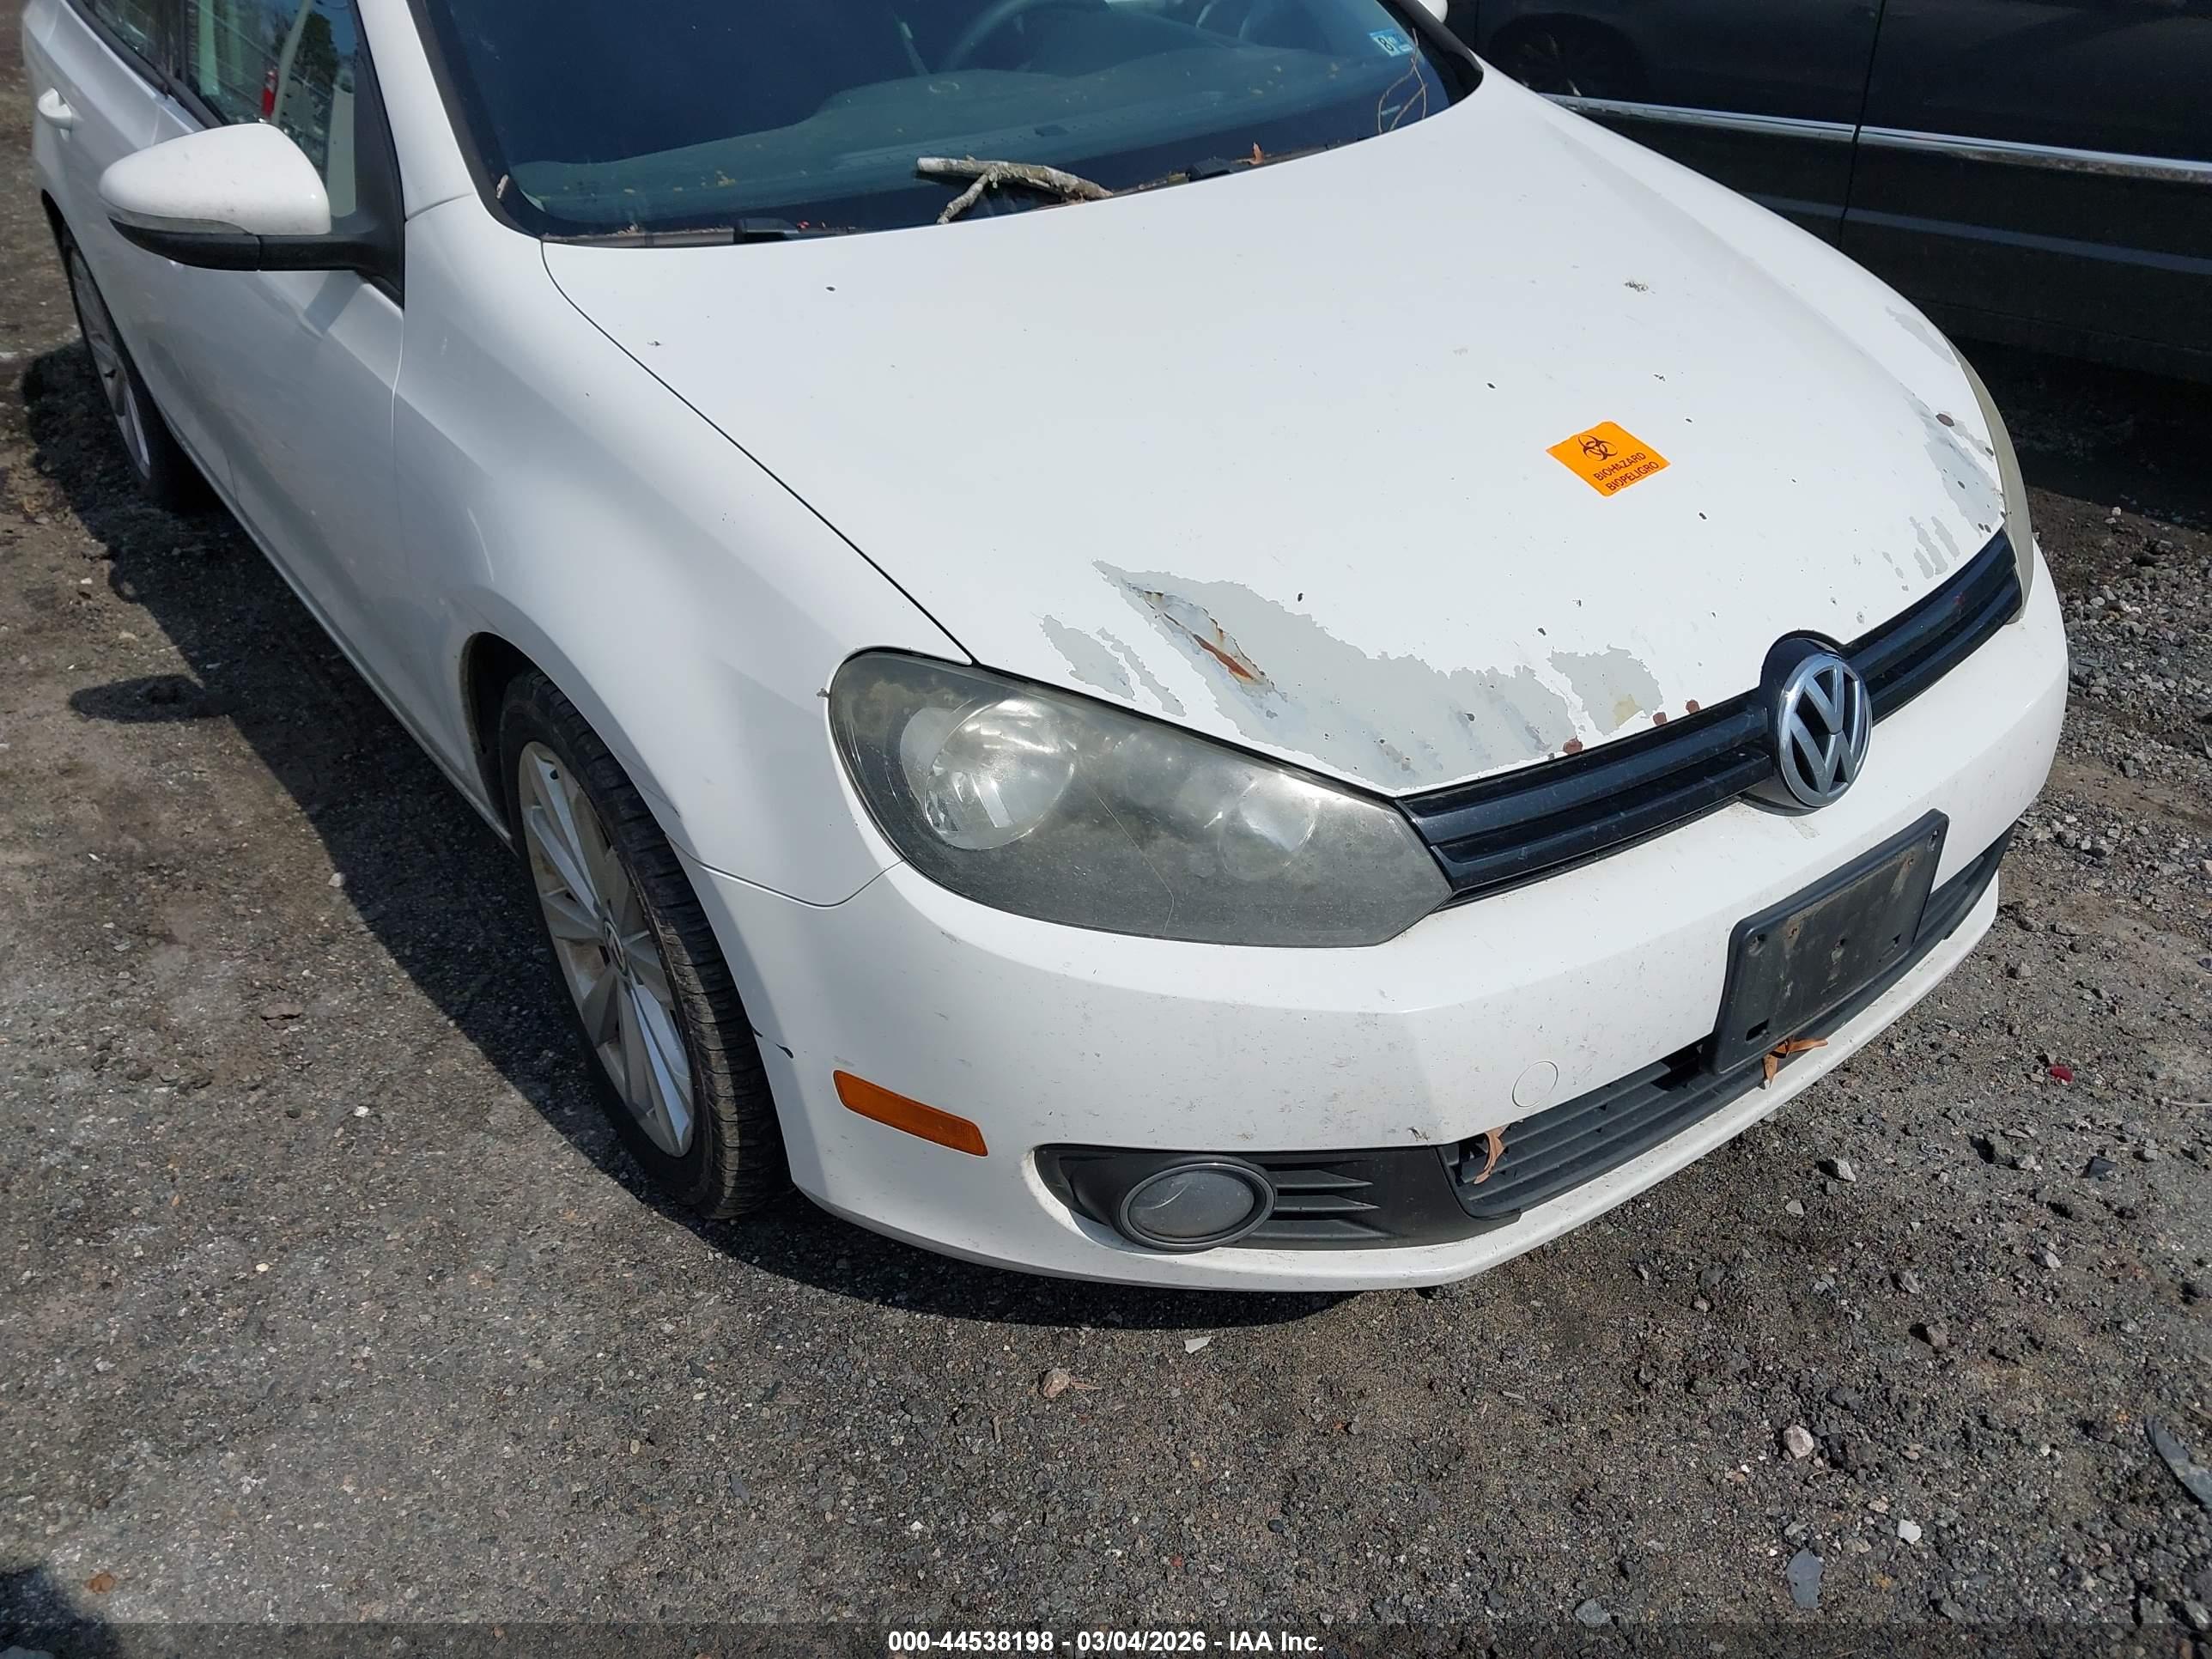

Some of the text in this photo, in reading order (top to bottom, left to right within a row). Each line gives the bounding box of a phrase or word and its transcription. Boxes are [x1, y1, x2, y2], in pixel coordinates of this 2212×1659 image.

[1593, 452, 1646, 481] BIOHAZARD
[1605, 461, 1659, 491] BIOPELIGRO
[1778, 653, 1872, 806] VW
